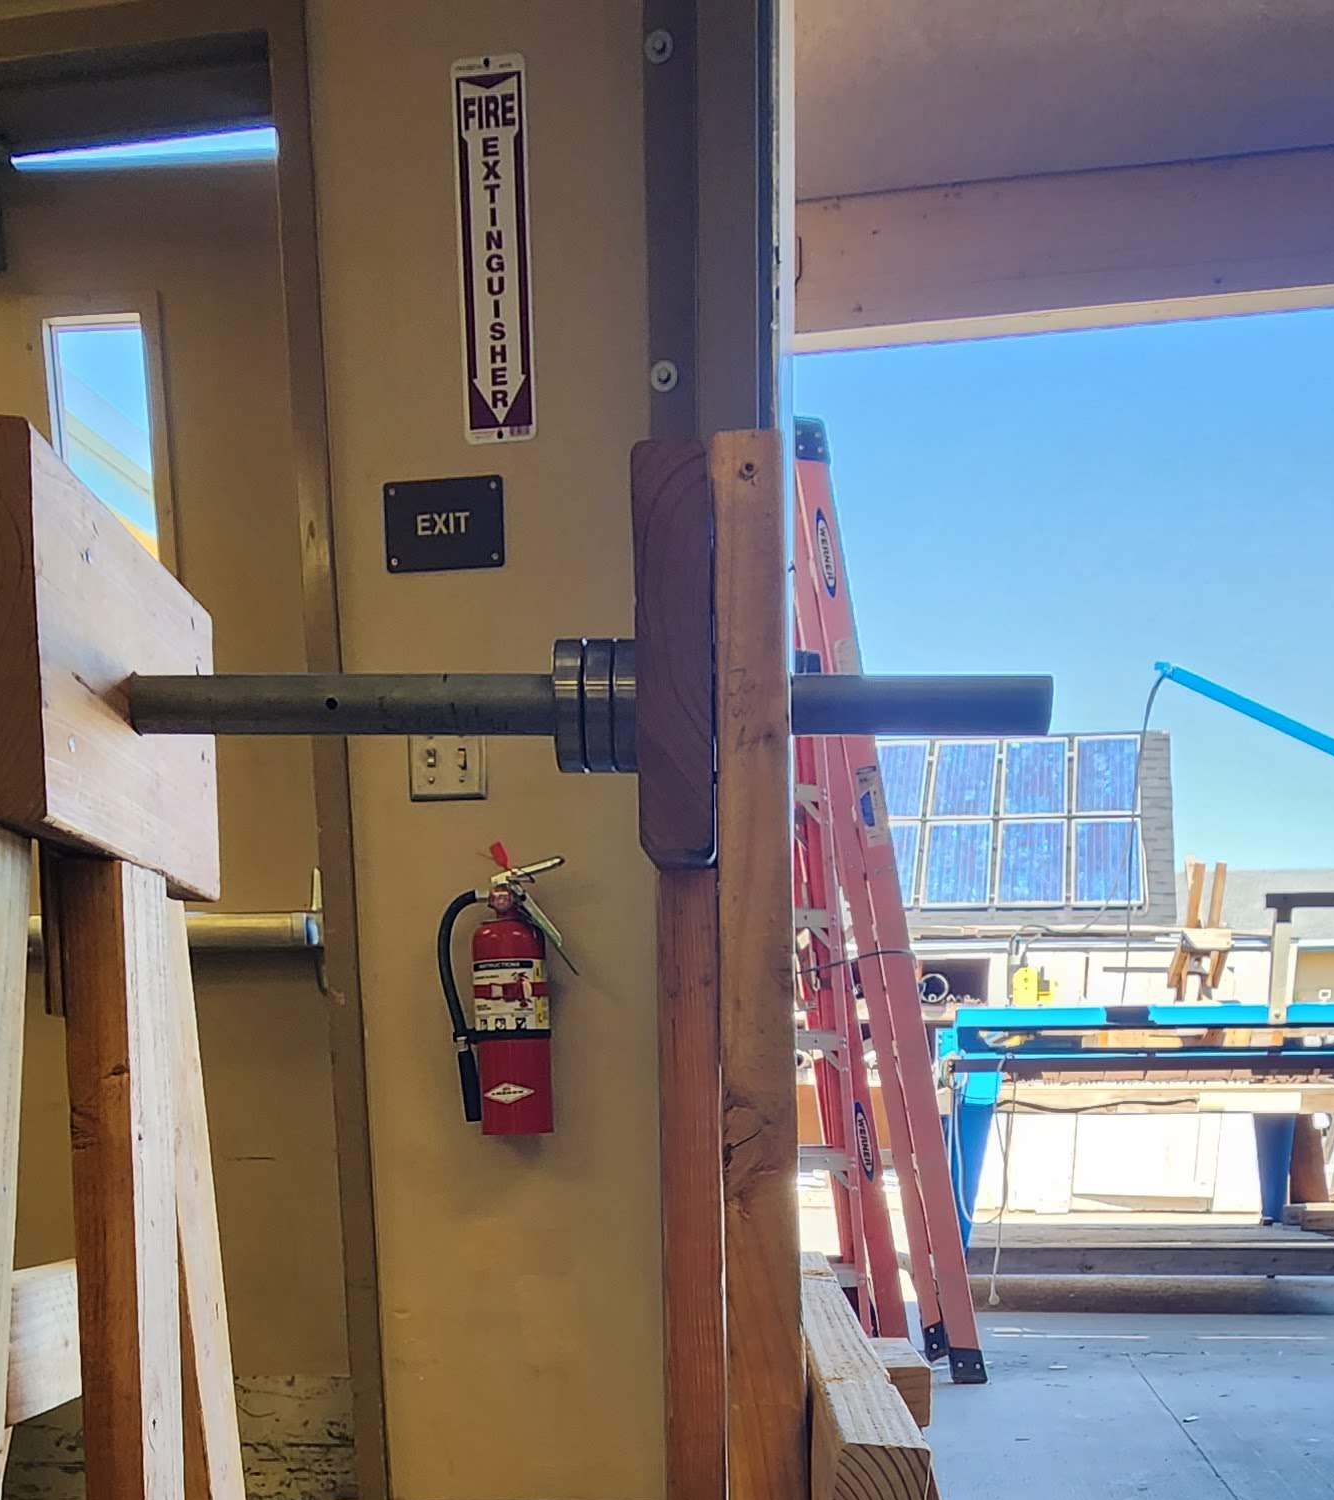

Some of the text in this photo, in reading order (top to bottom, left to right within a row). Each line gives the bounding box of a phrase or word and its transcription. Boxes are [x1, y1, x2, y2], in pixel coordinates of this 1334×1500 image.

[463, 93, 516, 131] FIRE
[481, 136, 509, 409] EXTINGUISHER
[416, 512, 470, 536] EXIT
[819, 526, 835, 580] WERNER
[857, 1118, 872, 1166] WERNER
